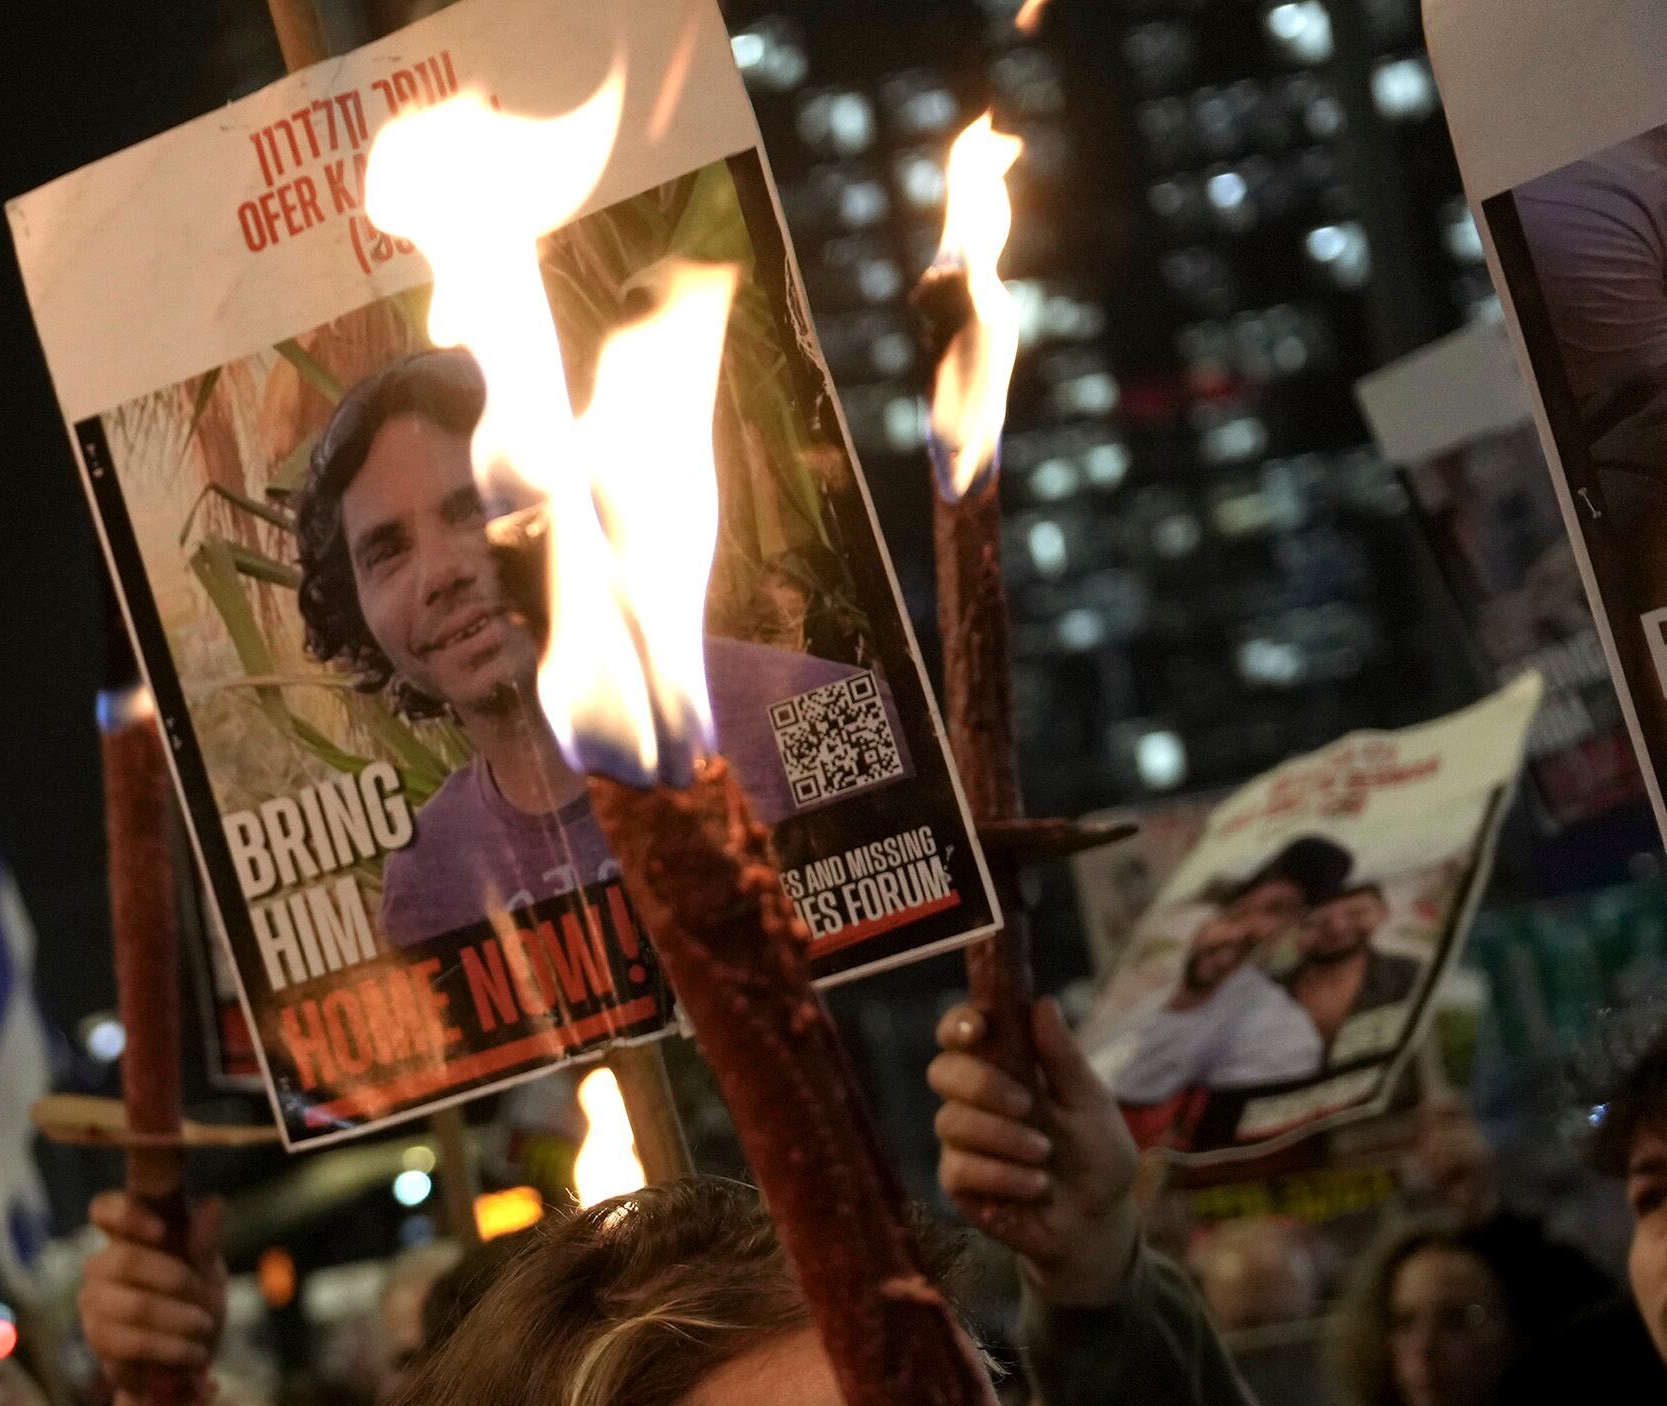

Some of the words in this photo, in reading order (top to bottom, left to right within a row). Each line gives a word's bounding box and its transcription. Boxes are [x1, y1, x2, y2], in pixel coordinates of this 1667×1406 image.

[237, 174, 325, 253] OFER
[222, 761, 414, 900] BRING
[805, 855, 847, 895] AND
[845, 825, 937, 882] MISSING
[250, 875, 377, 992] HIM
[842, 855, 951, 927] FORUM
[280, 957, 463, 1090] HOME
[460, 886, 647, 1033] NOW!
